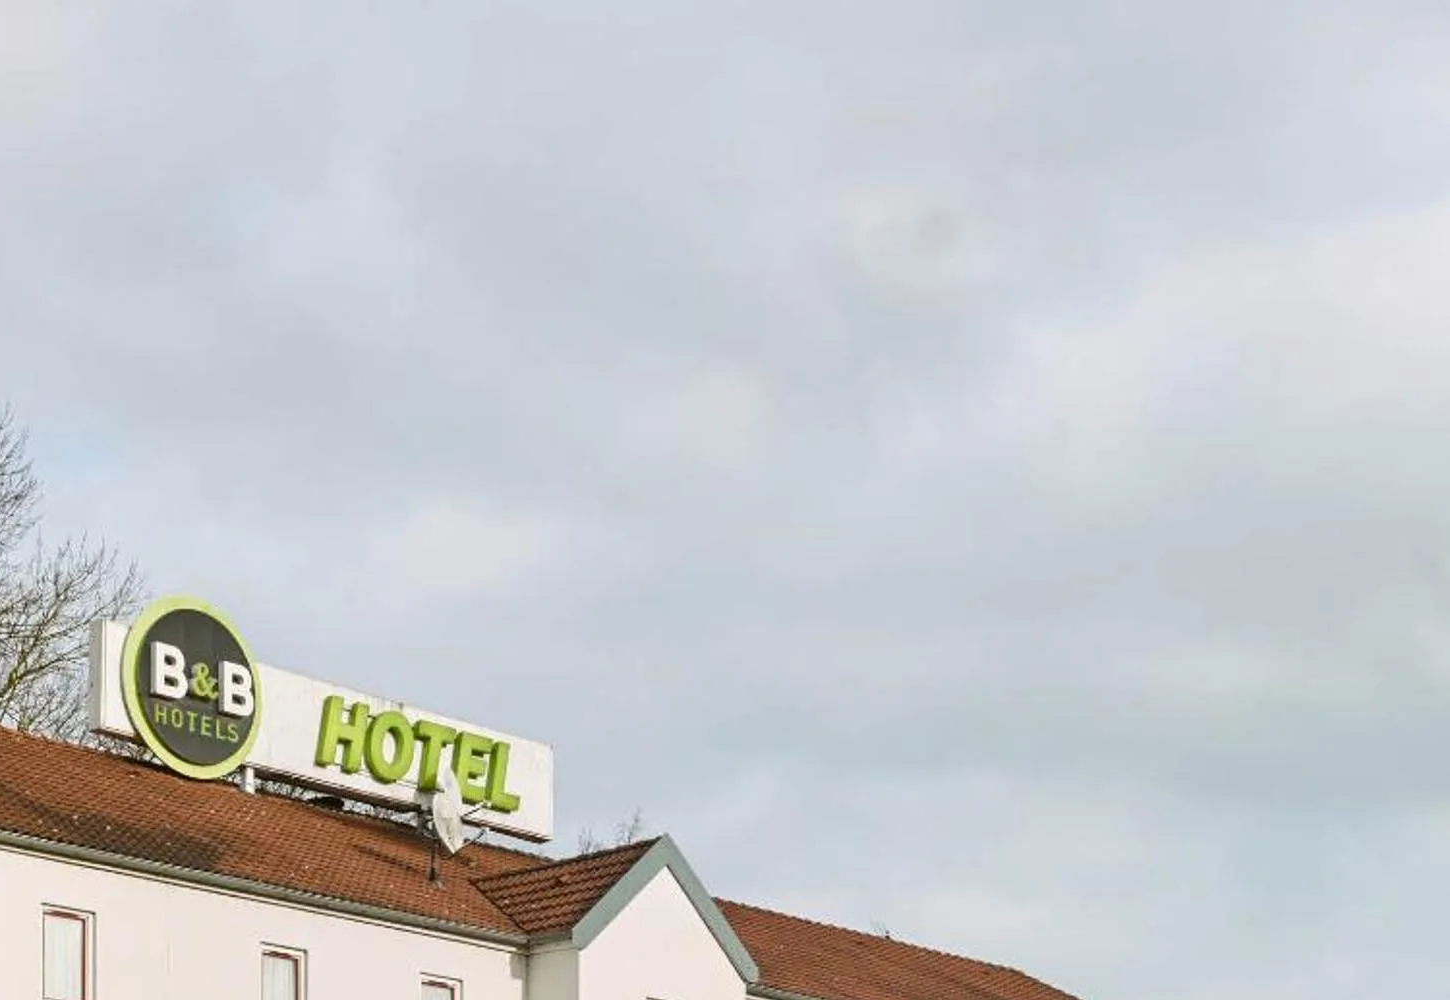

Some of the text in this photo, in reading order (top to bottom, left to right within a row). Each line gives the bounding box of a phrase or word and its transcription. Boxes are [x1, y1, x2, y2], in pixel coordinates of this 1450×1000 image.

[150, 641, 255, 716] B&B
[154, 703, 240, 743] HOTELS
[314, 694, 521, 813] HOTEL
